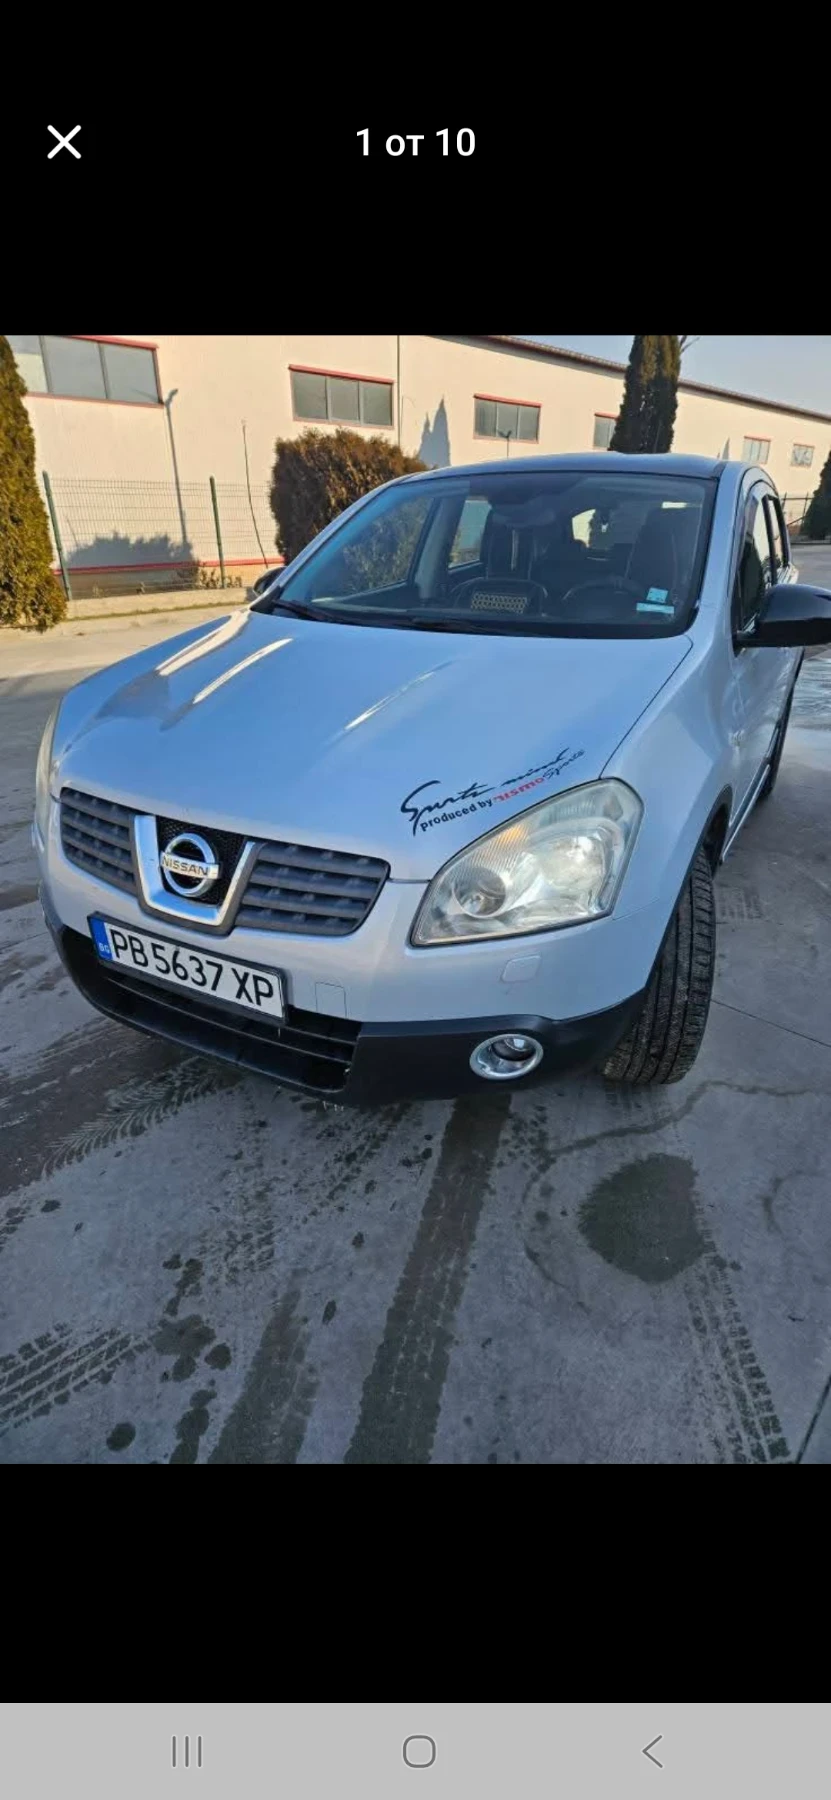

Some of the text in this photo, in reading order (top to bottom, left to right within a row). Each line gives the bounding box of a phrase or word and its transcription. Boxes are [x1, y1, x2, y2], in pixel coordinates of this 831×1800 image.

[419, 804, 478, 833] produced
[477, 798, 494, 810] by
[161, 856, 209, 876] NISSAN
[110, 929, 274, 1007] PB 5637 XP
